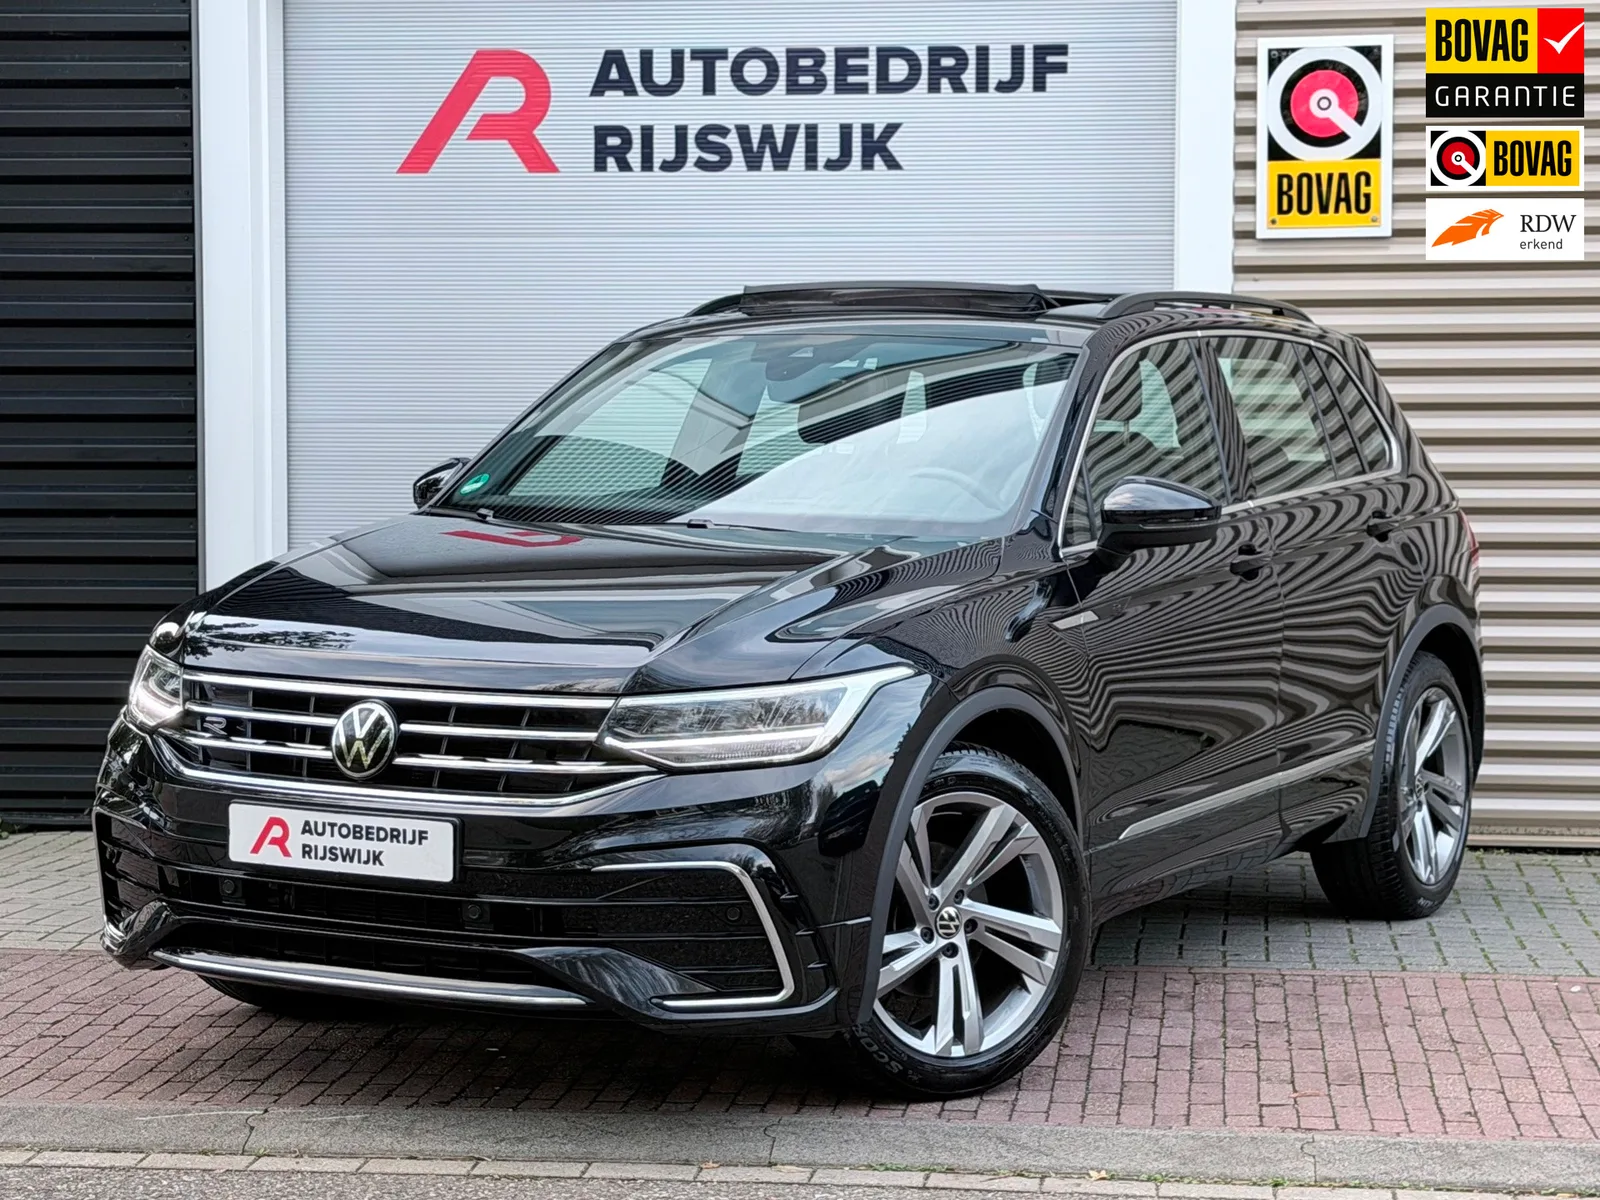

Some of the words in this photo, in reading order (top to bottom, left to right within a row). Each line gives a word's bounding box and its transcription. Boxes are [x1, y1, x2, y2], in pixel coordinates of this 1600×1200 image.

[589, 43, 1069, 97] AUTOBEDRIJF
[593, 122, 905, 173] RIJSWIJK
[1276, 170, 1372, 217] BOVAG
[301, 819, 430, 847] AUTOBEDRIJF
[301, 843, 385, 867] RIJSWIJK
